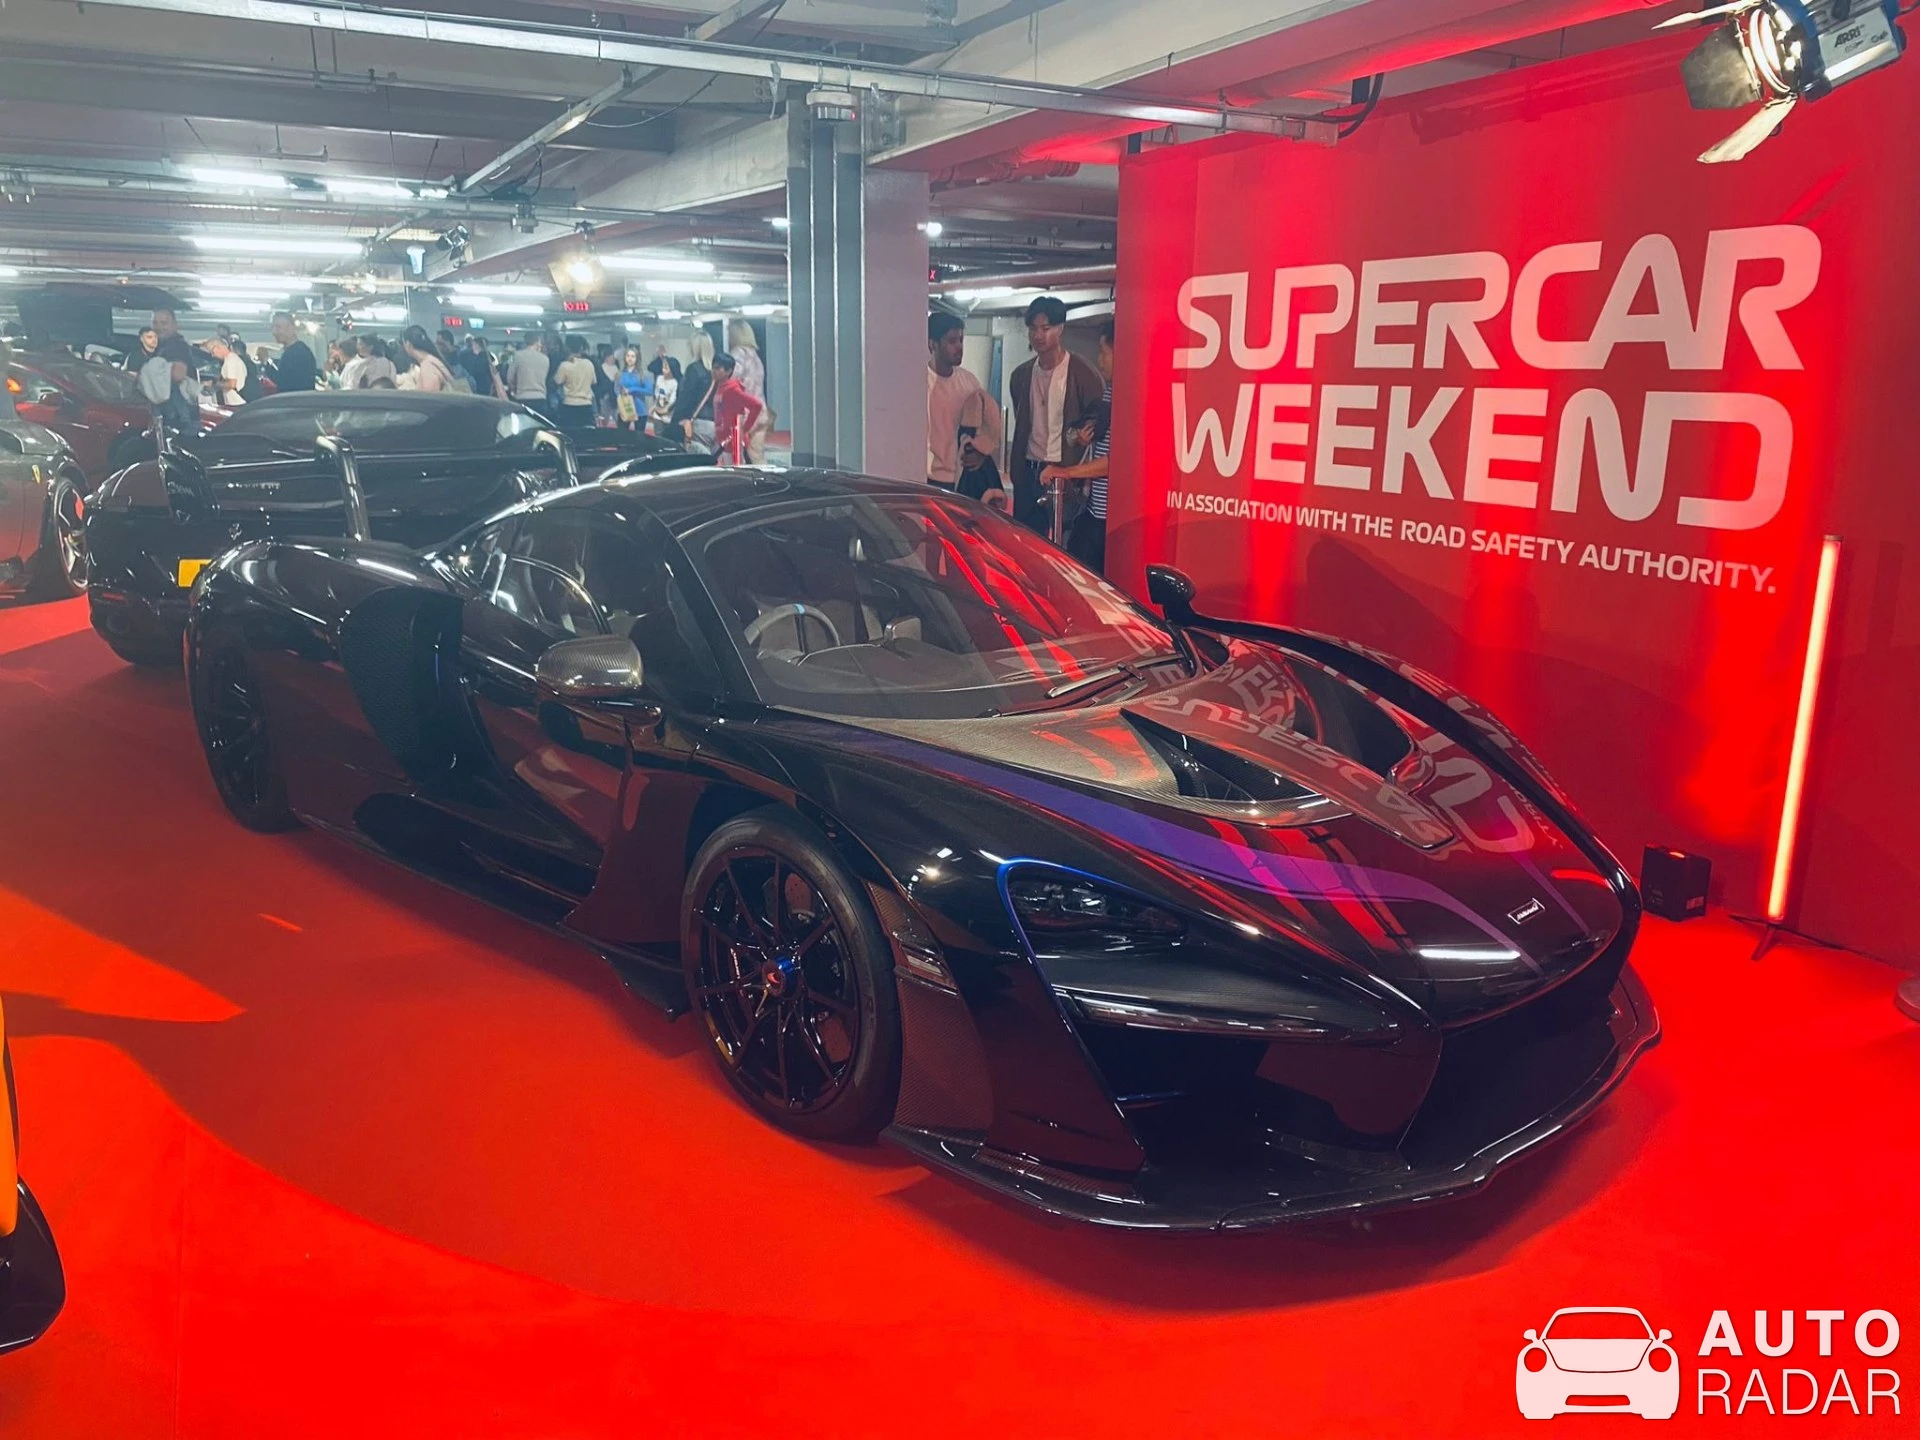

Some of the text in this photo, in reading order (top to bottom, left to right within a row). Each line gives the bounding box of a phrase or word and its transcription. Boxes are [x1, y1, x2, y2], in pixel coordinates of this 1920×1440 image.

[1173, 224, 1821, 370] SUPERCAR
[1172, 383, 1793, 530] WEEKEND
[1167, 491, 1776, 594] IN ASSOCIATION WITH THE ROAD SAFETY AUTHORITY.
